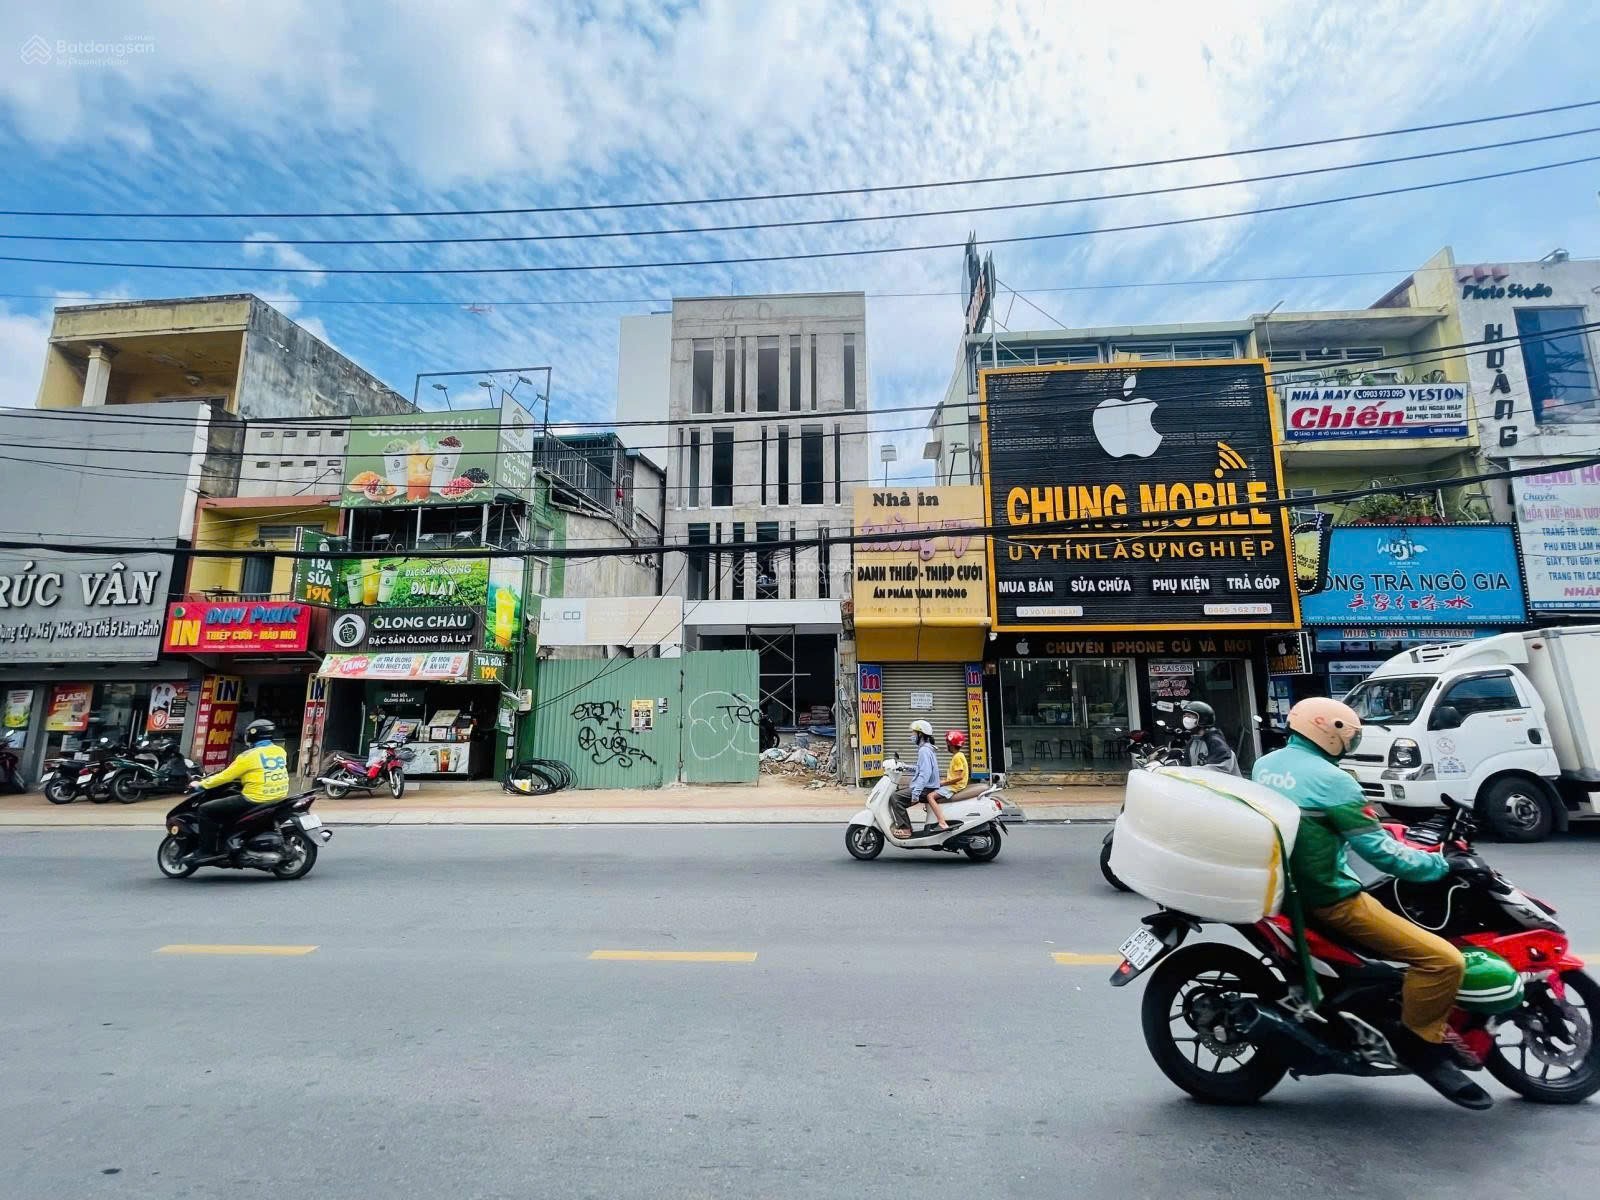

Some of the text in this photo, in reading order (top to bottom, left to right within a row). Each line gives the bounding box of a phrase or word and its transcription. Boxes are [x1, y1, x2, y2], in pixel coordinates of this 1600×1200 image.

[1291, 387, 1319, 401] NHÀ
[1322, 389, 1352, 401] MAY
[1408, 387, 1464, 401] VESTON
[1291, 400, 1405, 430] Chiến
[872, 492, 940, 507] Nhà in
[1007, 480, 1272, 530] CHUNG MOBILE
[307, 570, 332, 588] SỮA
[857, 561, 983, 584] DANH THIẾP THIỆP CƯỚI
[1369, 568, 1415, 592] TRÀ
[1420, 568, 1467, 592] NGÔ
[1473, 572, 1512, 591] GIA
[1548, 571, 1572, 580] TRANG
[80, 560, 160, 606] VÂN
[998, 573, 1281, 594] MUA BÁN SỬA CHỮA PHỤ KIỆN TRẢ GÓP
[306, 585, 332, 603] 19K
[935, 586, 968, 599] PHÒNG
[0, 617, 160, 643] ụng Cụ Máy Móc Pha Chế & Làm Bánh
[373, 613, 467, 629] ÔLONG CHÂU
[170, 619, 201, 646] IN
[368, 633, 473, 647] ĐẶC SẢN ÔLONG ĐÀ LẠT
[1343, 627, 1475, 641] MUA 5 TẶNG 1 EVERYDAY
[1111, 640, 1165, 653] IPHONE
[1198, 637, 1217, 653] VÀ
[477, 656, 489, 666] TRÀ
[1161, 664, 1192, 672] SAISON
[861, 668, 880, 690] in
[967, 665, 981, 685] in
[865, 720, 877, 738] vy
[260, 754, 286, 770] be
[1258, 769, 1296, 790] Grab
